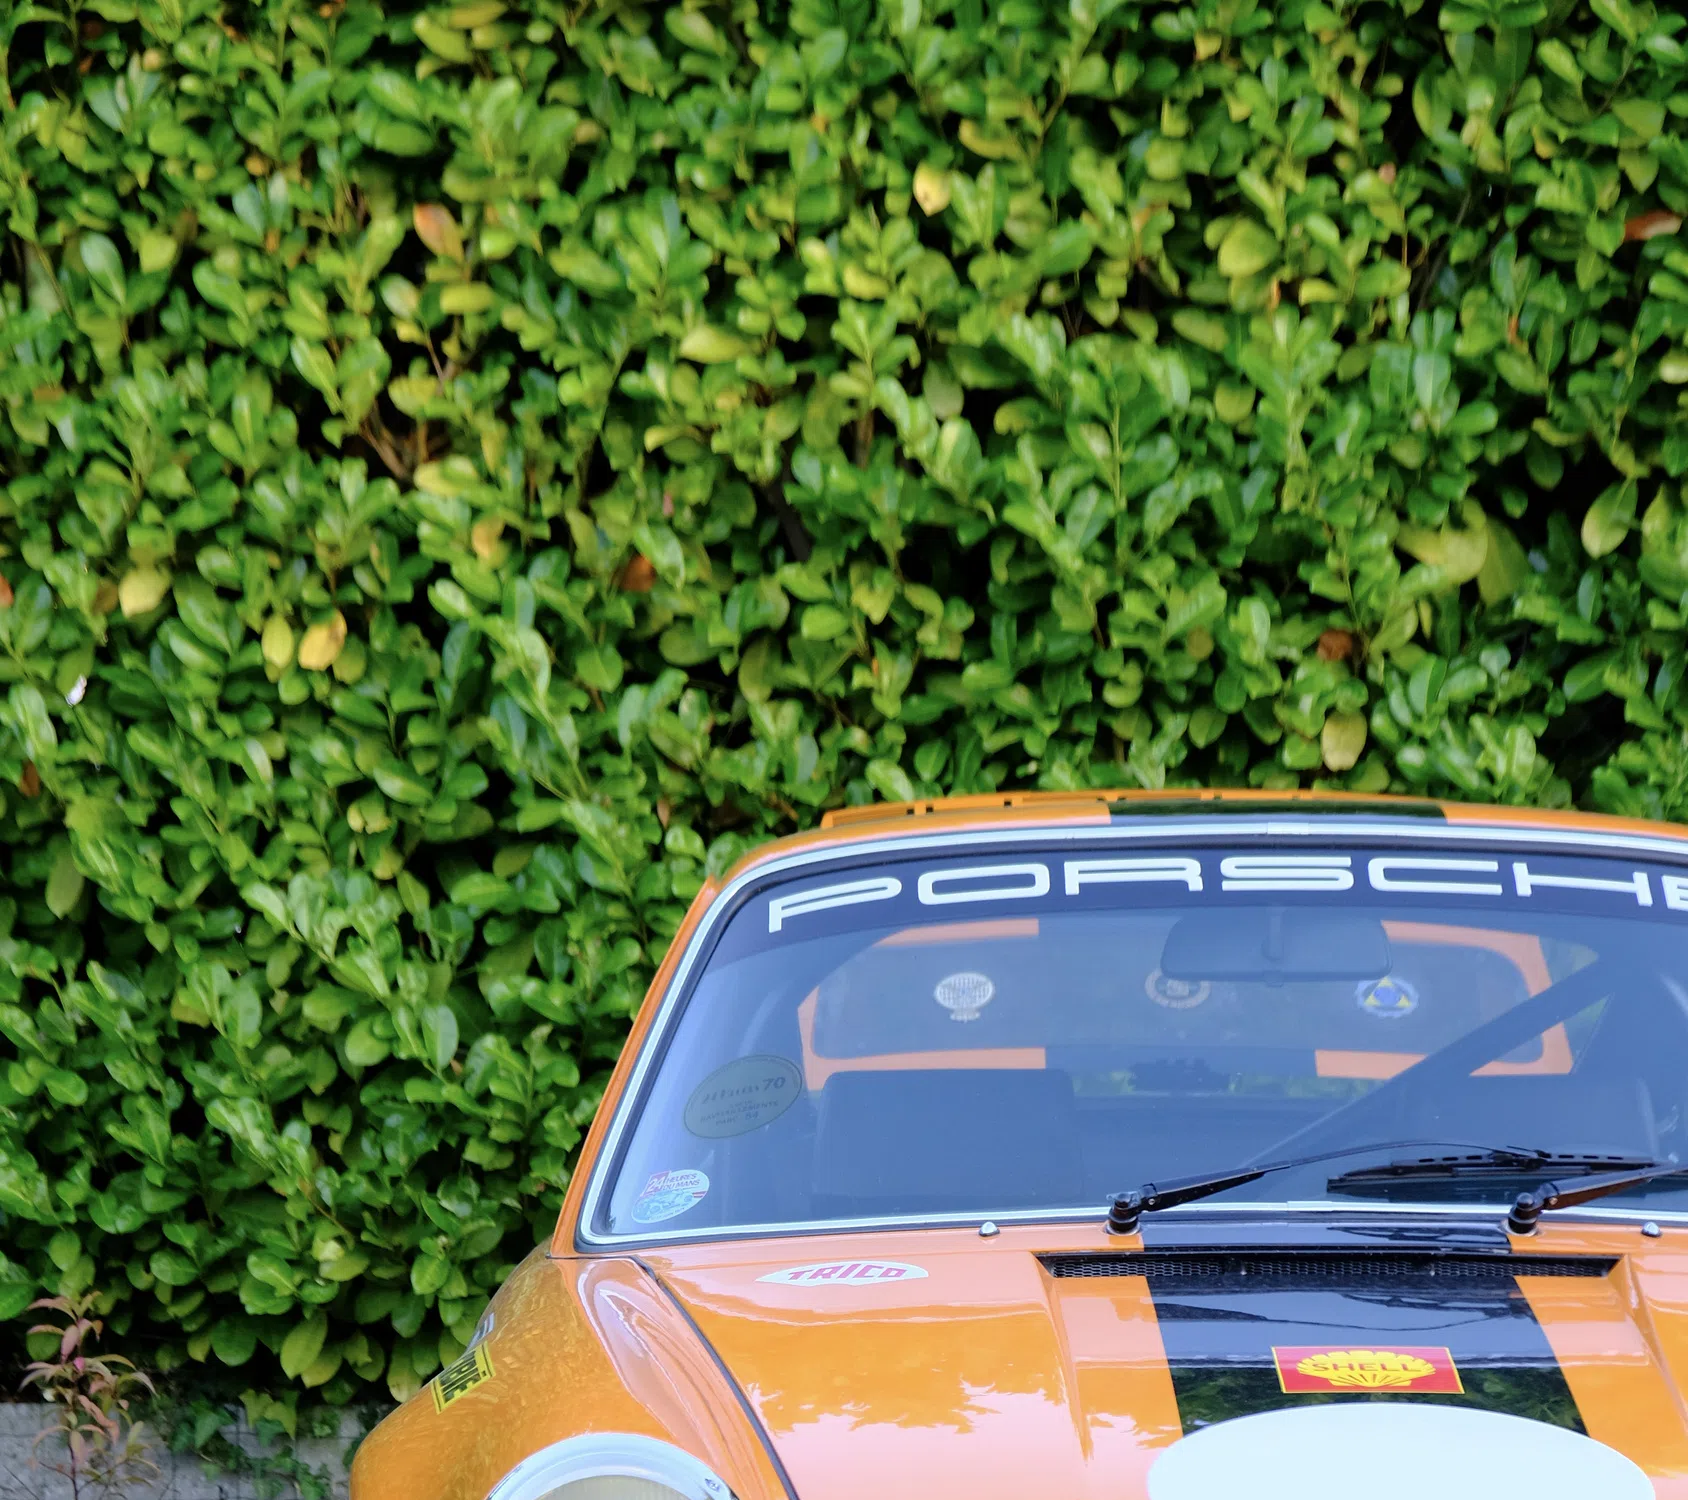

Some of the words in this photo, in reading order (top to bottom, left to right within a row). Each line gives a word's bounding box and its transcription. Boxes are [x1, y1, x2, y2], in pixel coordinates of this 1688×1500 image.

[768, 856, 1688, 934] PORSCH
[788, 1263, 908, 1281] TRICO
[1311, 1360, 1422, 1372] SHELL
